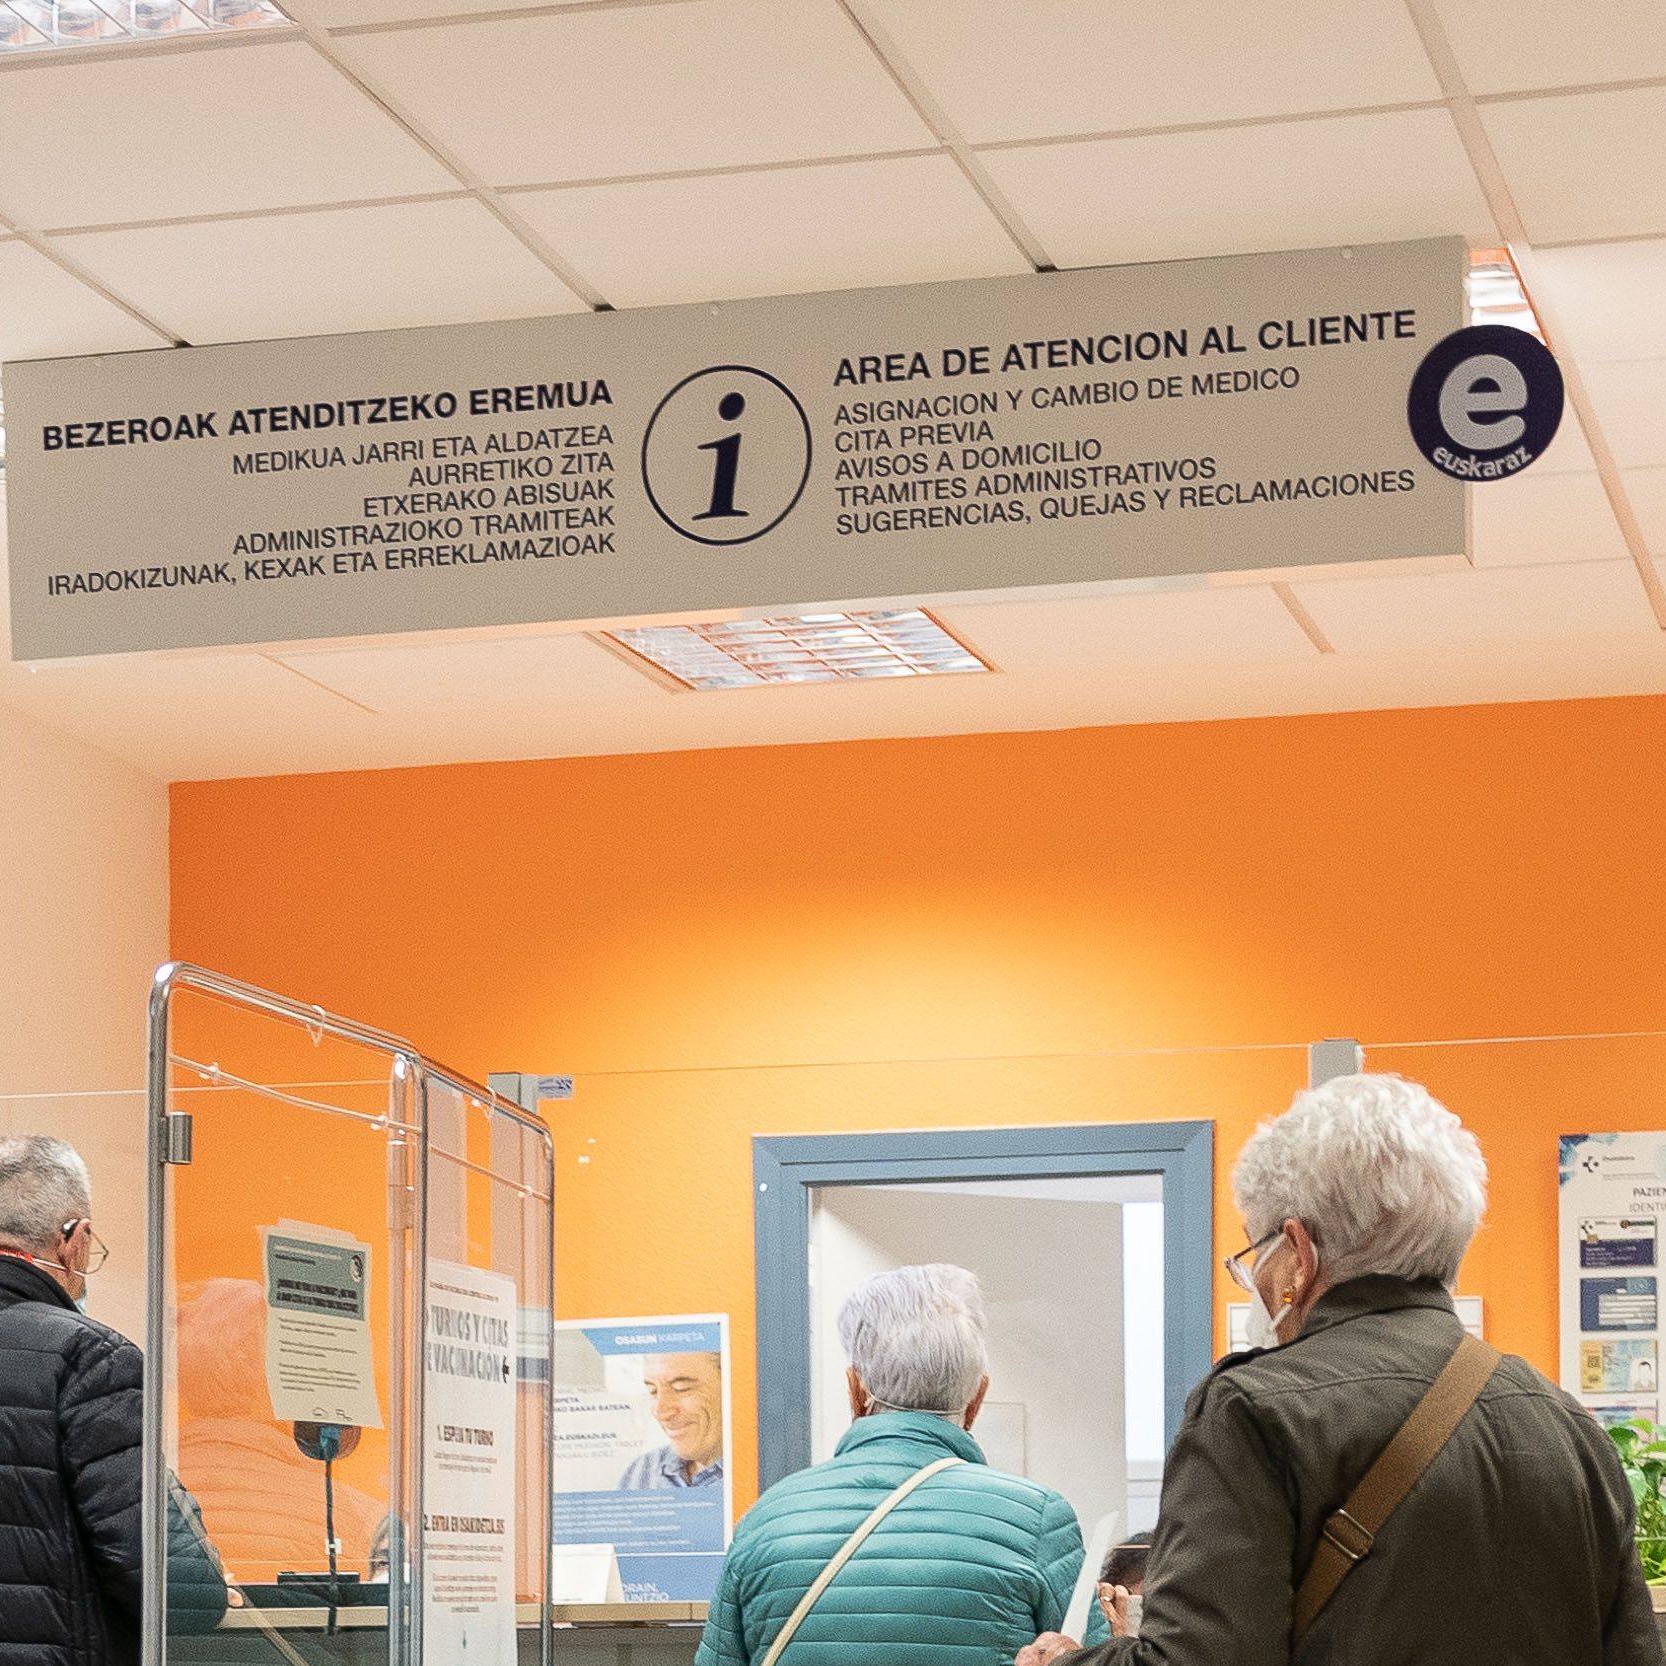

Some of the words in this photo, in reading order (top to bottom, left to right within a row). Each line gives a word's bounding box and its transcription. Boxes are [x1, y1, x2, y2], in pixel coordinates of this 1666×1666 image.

[833, 351, 932, 387] AREA
[942, 345, 991, 378] DE
[1000, 328, 1188, 373] ATENCION
[1199, 324, 1248, 356] AL
[1257, 309, 1417, 351] CLIENTE
[43, 411, 218, 451] BEZEROAK
[229, 391, 458, 436] ATENDITZEKO
[470, 379, 614, 416] EREMUA
[833, 391, 998, 426] ASIGNACION
[1005, 389, 1023, 411] Y
[1031, 379, 1139, 410] CAMBIO
[1147, 375, 1183, 400] DE
[1191, 366, 1300, 396] MEDICO
[1439, 354, 1528, 450] e
[233, 446, 347, 475] MEDIKUA
[352, 439, 424, 466] JARRI
[432, 435, 478, 459] ETA
[484, 424, 614, 455] ALDATZEA
[834, 428, 893, 453] CITA
[900, 419, 995, 448] PREVIA
[834, 452, 929, 481] AVISOS
[935, 450, 955, 473] A
[962, 438, 1102, 471] DOMICILIO
[1433, 446, 1532, 477] euskaraz
[408, 455, 554, 488] AURRETIKO
[560, 451, 615, 476] ZITA
[834, 476, 968, 508] TRAMITES
[974, 456, 1217, 497] ADMINISTRATIVOS
[363, 487, 496, 518] ETXERAKO
[503, 478, 615, 507] ABISUAK
[836, 500, 1032, 536] SUGERENCIAS,
[1039, 490, 1146, 520] QUEJAS
[1153, 488, 1171, 510] Y
[1179, 469, 1415, 509] RECLAMACIONES
[232, 517, 463, 555] ADMINISTRAZIOKO
[469, 505, 615, 536] TRAMITEAK
[48, 562, 237, 596] IRADOKIZUNAK,
[244, 555, 326, 581] KEXAK
[333, 551, 378, 574] ETA
[384, 532, 616, 570] ERREKLAMAZIOAK
